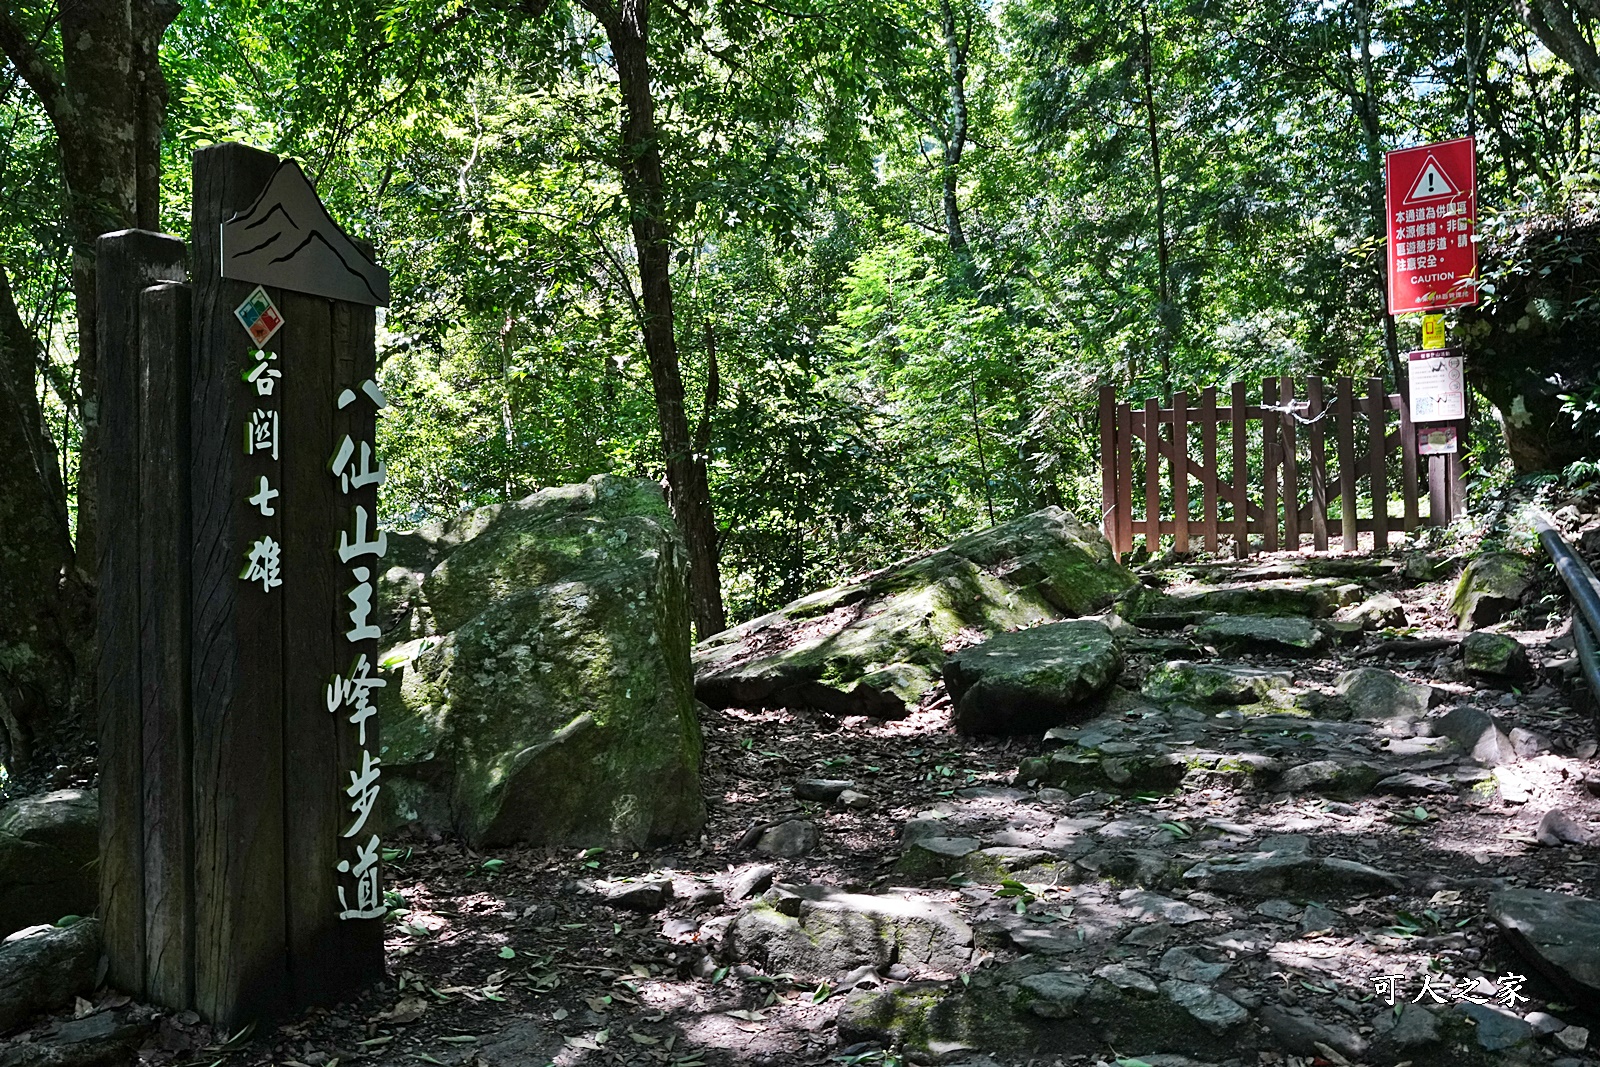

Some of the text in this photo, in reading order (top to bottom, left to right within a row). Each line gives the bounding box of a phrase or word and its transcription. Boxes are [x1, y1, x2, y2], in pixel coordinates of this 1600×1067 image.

[1396, 254, 1445, 272] 注意安全。
[1410, 272, 1455, 284] CAUTION
[248, 350, 283, 593] 谷關七雄
[327, 379, 388, 920] 八仙山主峰步道
